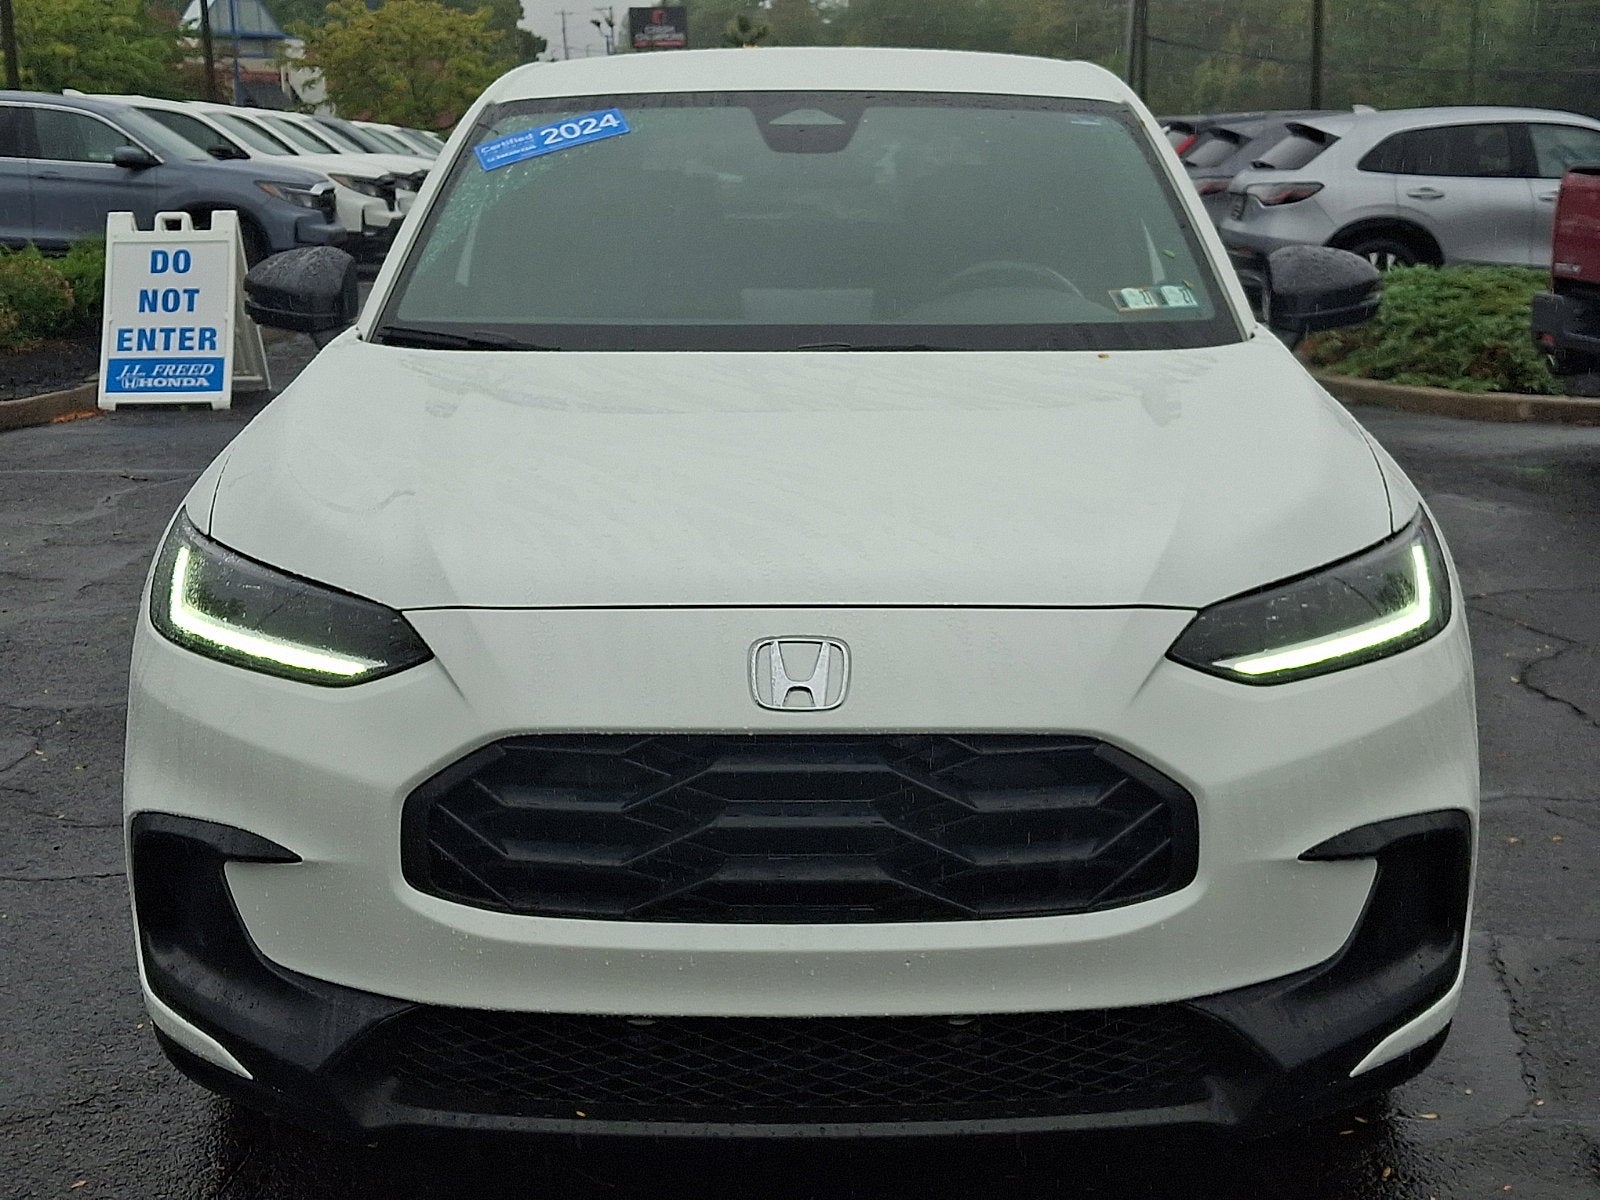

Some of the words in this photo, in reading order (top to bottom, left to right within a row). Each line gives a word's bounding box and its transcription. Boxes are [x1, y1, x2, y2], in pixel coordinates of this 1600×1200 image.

[539, 113, 620, 145] 2024
[150, 249, 191, 274] DO
[138, 288, 200, 313] NOT
[116, 327, 218, 352] ENTER
[139, 376, 211, 388] HONDA
[151, 363, 215, 377] FREED
